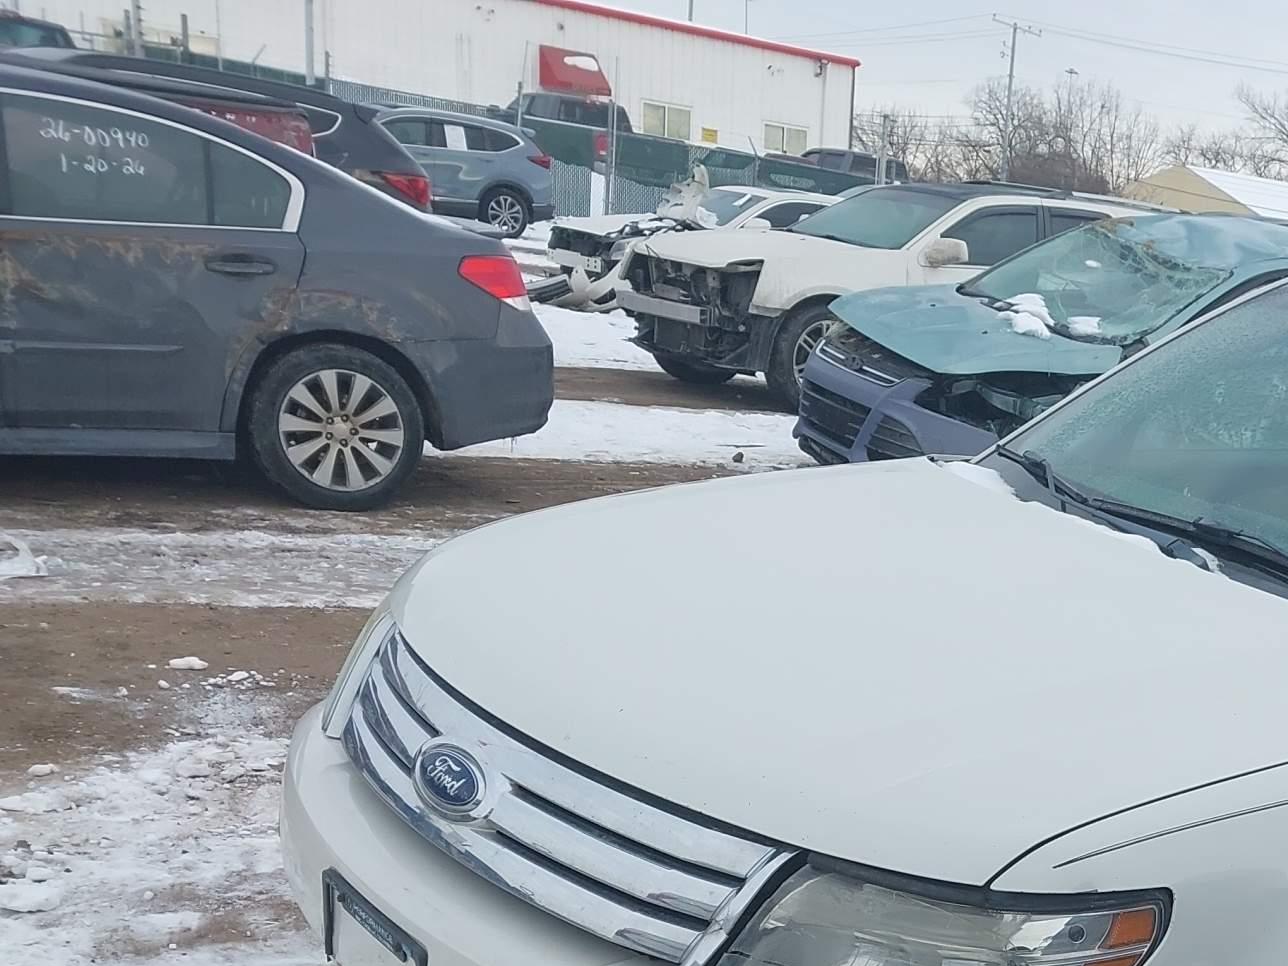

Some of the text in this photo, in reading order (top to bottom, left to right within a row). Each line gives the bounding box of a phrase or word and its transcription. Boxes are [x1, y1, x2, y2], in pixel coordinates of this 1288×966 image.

[40, 117, 149, 148] 26-00940
[60, 153, 145, 175] 1-20-26
[426, 755, 467, 796] Ford
